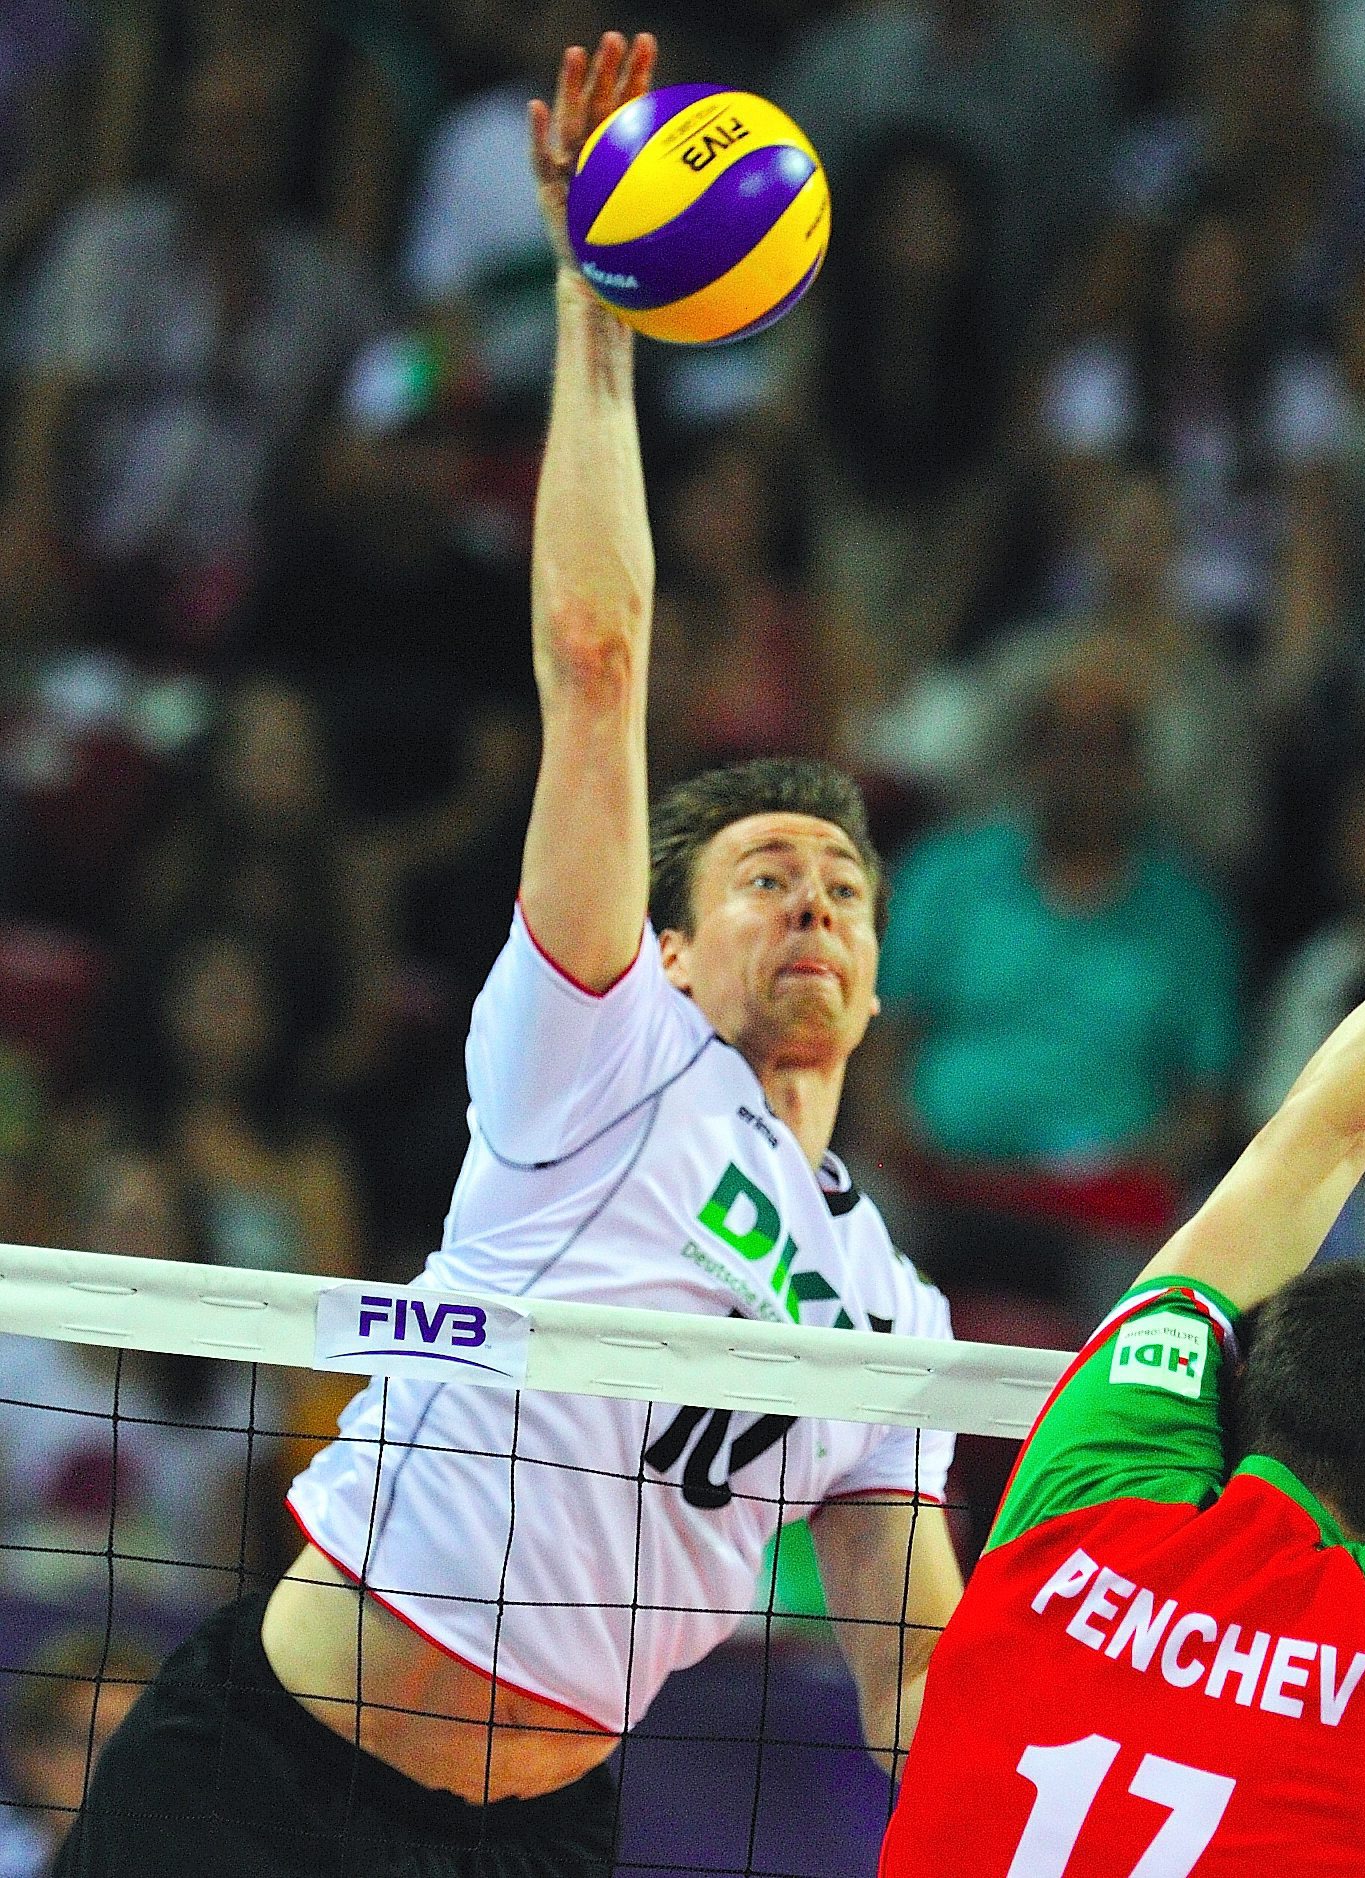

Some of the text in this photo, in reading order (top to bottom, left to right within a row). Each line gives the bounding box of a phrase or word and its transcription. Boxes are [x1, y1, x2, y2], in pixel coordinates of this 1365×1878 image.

[681, 117, 750, 172] FIVB
[358, 1295, 487, 1348] FIVB
[1119, 1343, 1198, 1378] HDI
[1005, 1732, 1238, 1878] 17
